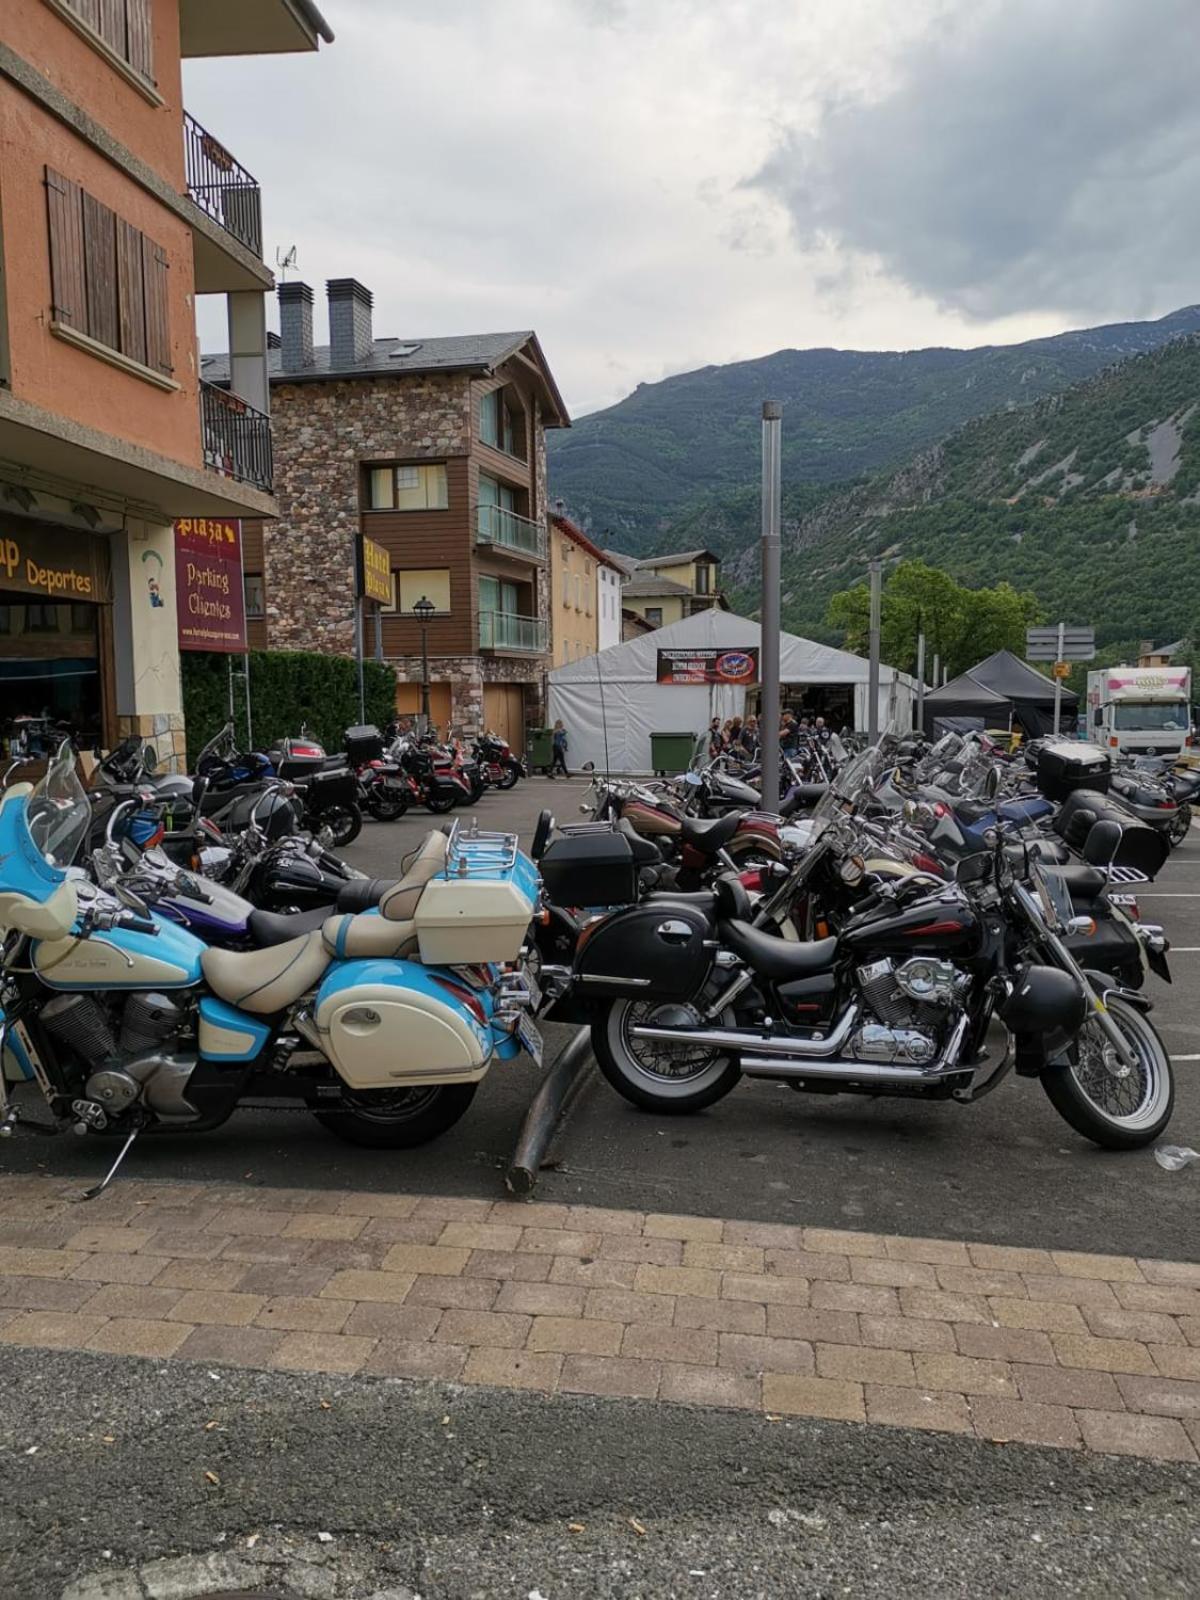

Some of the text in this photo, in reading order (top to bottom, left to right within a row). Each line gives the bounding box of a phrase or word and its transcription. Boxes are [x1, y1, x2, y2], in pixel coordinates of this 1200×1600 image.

[27, 559, 91, 594] Deportes
[187, 563, 229, 594] Parking
[189, 593, 231, 620] Clientes
